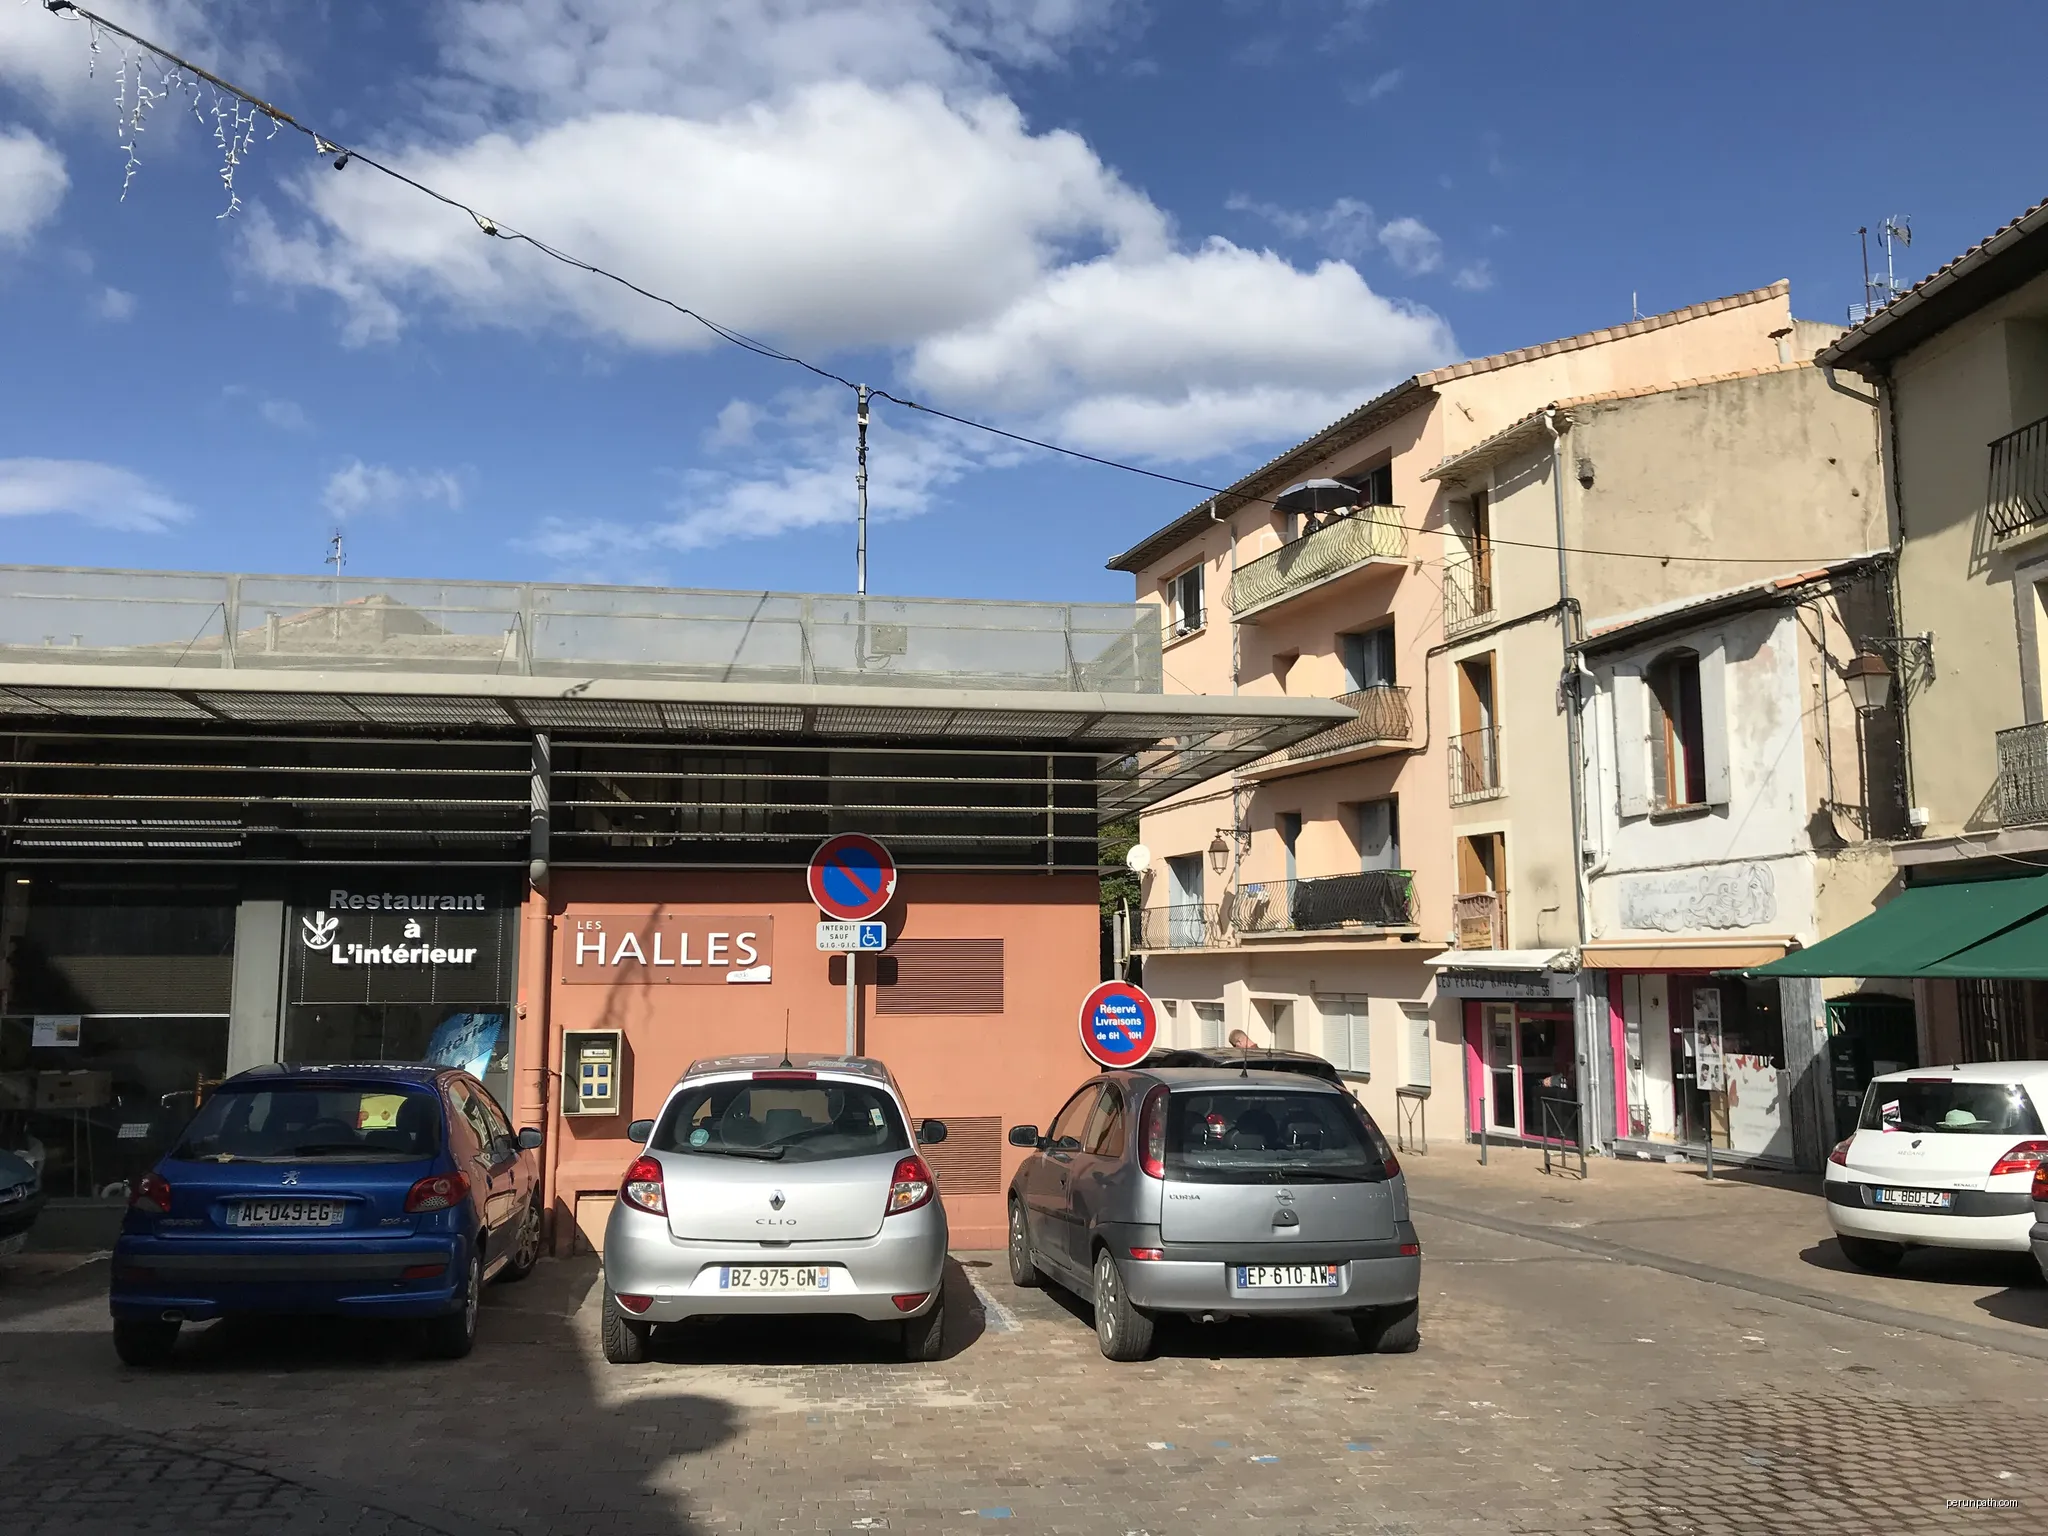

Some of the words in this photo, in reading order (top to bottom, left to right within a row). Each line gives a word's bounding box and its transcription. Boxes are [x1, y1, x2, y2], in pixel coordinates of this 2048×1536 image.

[329, 889, 485, 911] Restaurant
[404, 918, 421, 938] à
[577, 920, 603, 930] LES
[331, 943, 478, 964] L'intérieur
[575, 931, 758, 966] HALLES
[1099, 1004, 1136, 1014] Réservé
[1095, 1016, 1142, 1026] Livraisons
[1096, 1032, 1107, 1040] de
[1108, 1032, 1120, 1040] 6H
[1128, 1032, 1142, 1040] 10H
[242, 1203, 330, 1221] AC-049-EG
[755, 1218, 797, 1226] CLIO
[731, 1268, 817, 1287] BZ-975-GN
